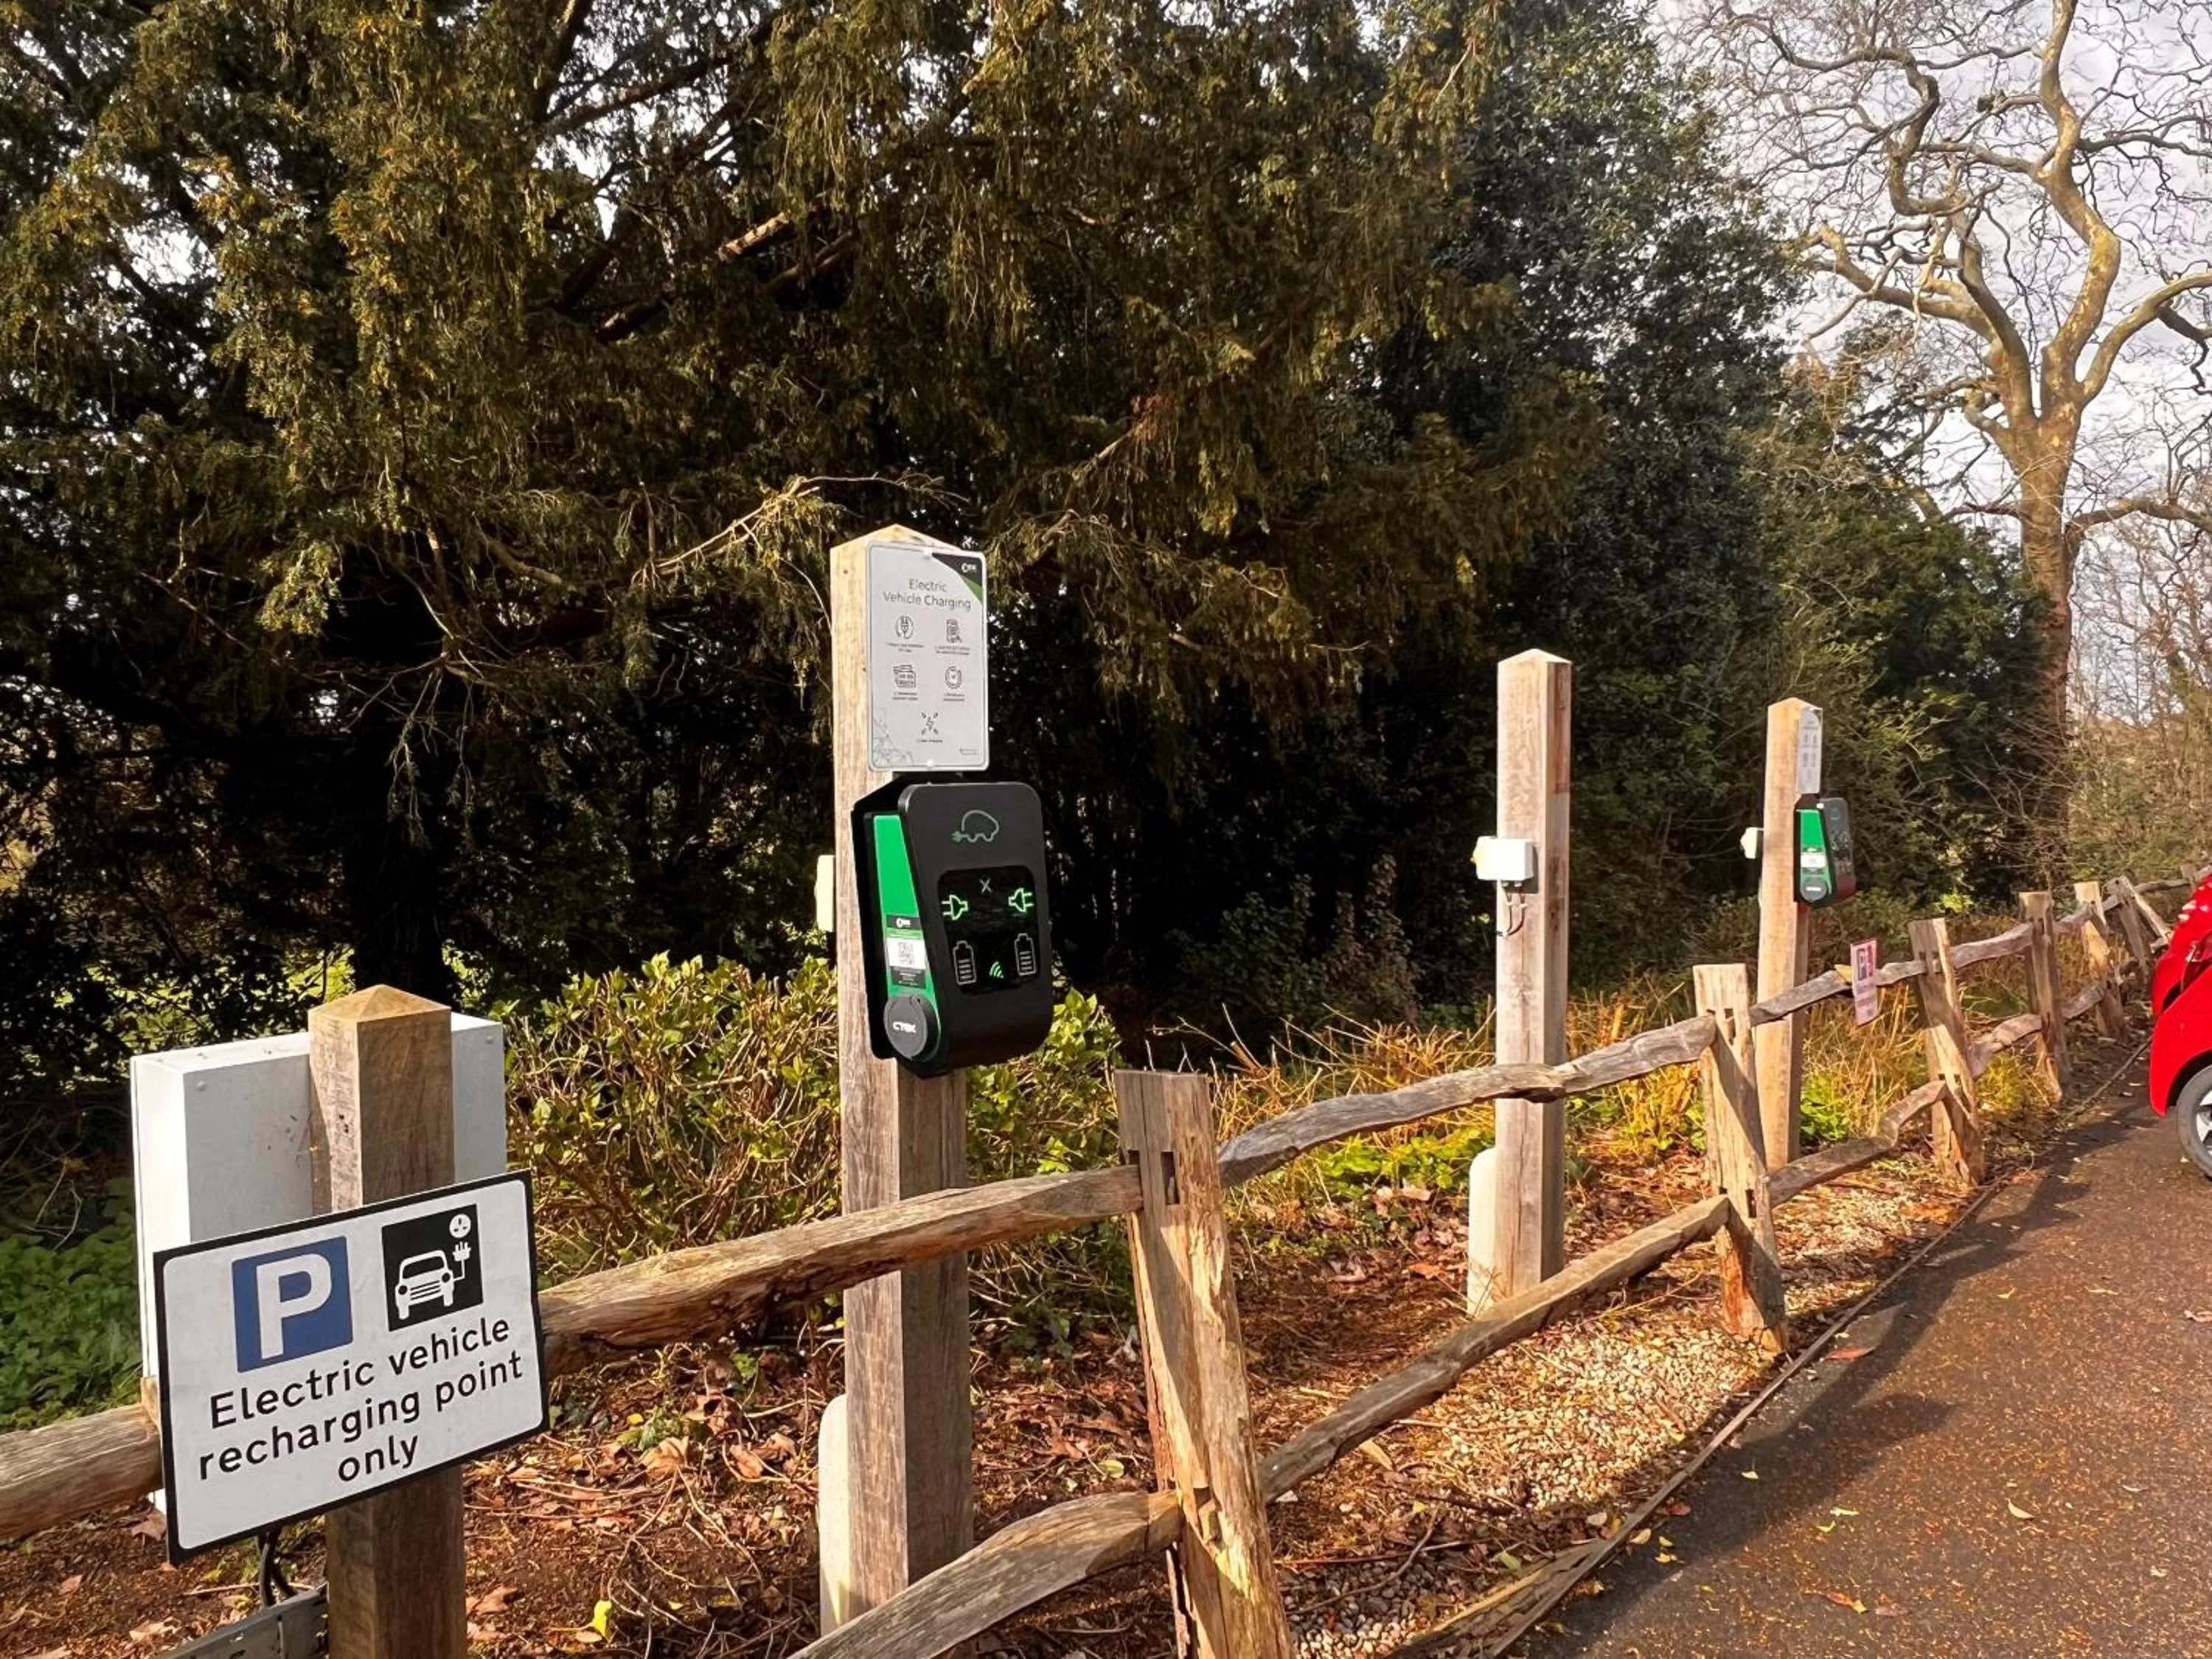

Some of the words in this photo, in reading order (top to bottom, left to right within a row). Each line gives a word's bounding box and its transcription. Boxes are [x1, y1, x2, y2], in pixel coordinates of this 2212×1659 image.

[883, 591, 922, 605] Vehicle
[924, 595, 972, 612] Charging
[908, 578, 947, 592] Electric
[256, 1253, 331, 1359] P
[210, 1359, 375, 1429] Electric
[389, 1317, 509, 1375] vehicle
[200, 1391, 420, 1479] recharging
[436, 1353, 523, 1411] point
[338, 1435, 418, 1482] only
